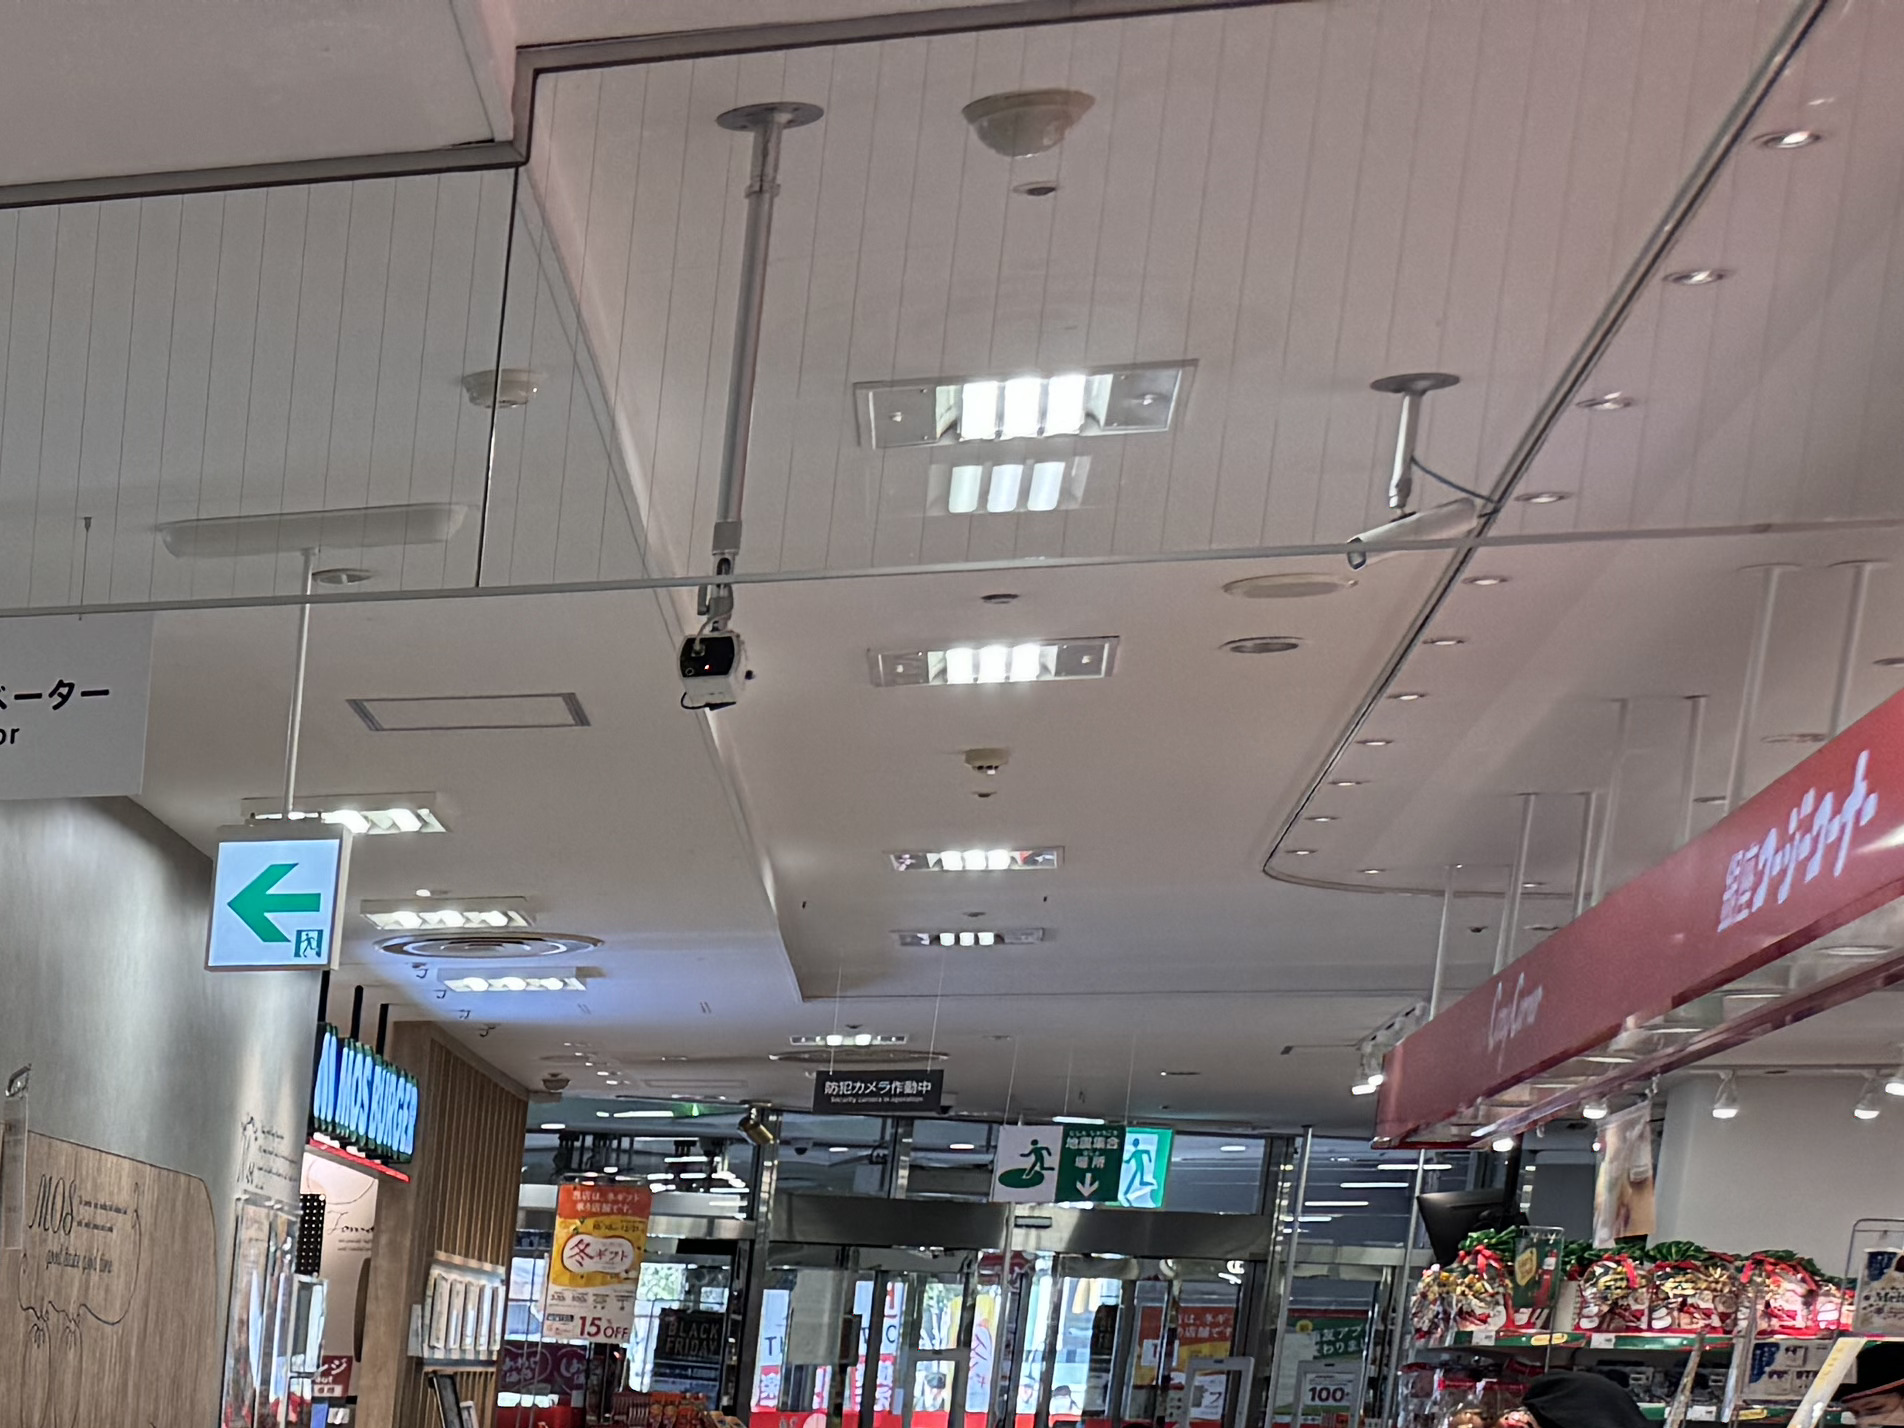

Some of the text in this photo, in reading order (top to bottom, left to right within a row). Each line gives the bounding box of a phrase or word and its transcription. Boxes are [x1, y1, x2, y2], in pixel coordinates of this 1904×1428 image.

[824, 1080, 932, 1095] 防犯カメラ作動中
[29, 1173, 77, 1236] MOS
[568, 1238, 629, 1267] 冬ギフト
[668, 1322, 720, 1339] BLACK
[666, 1338, 718, 1355] FRIDAY
